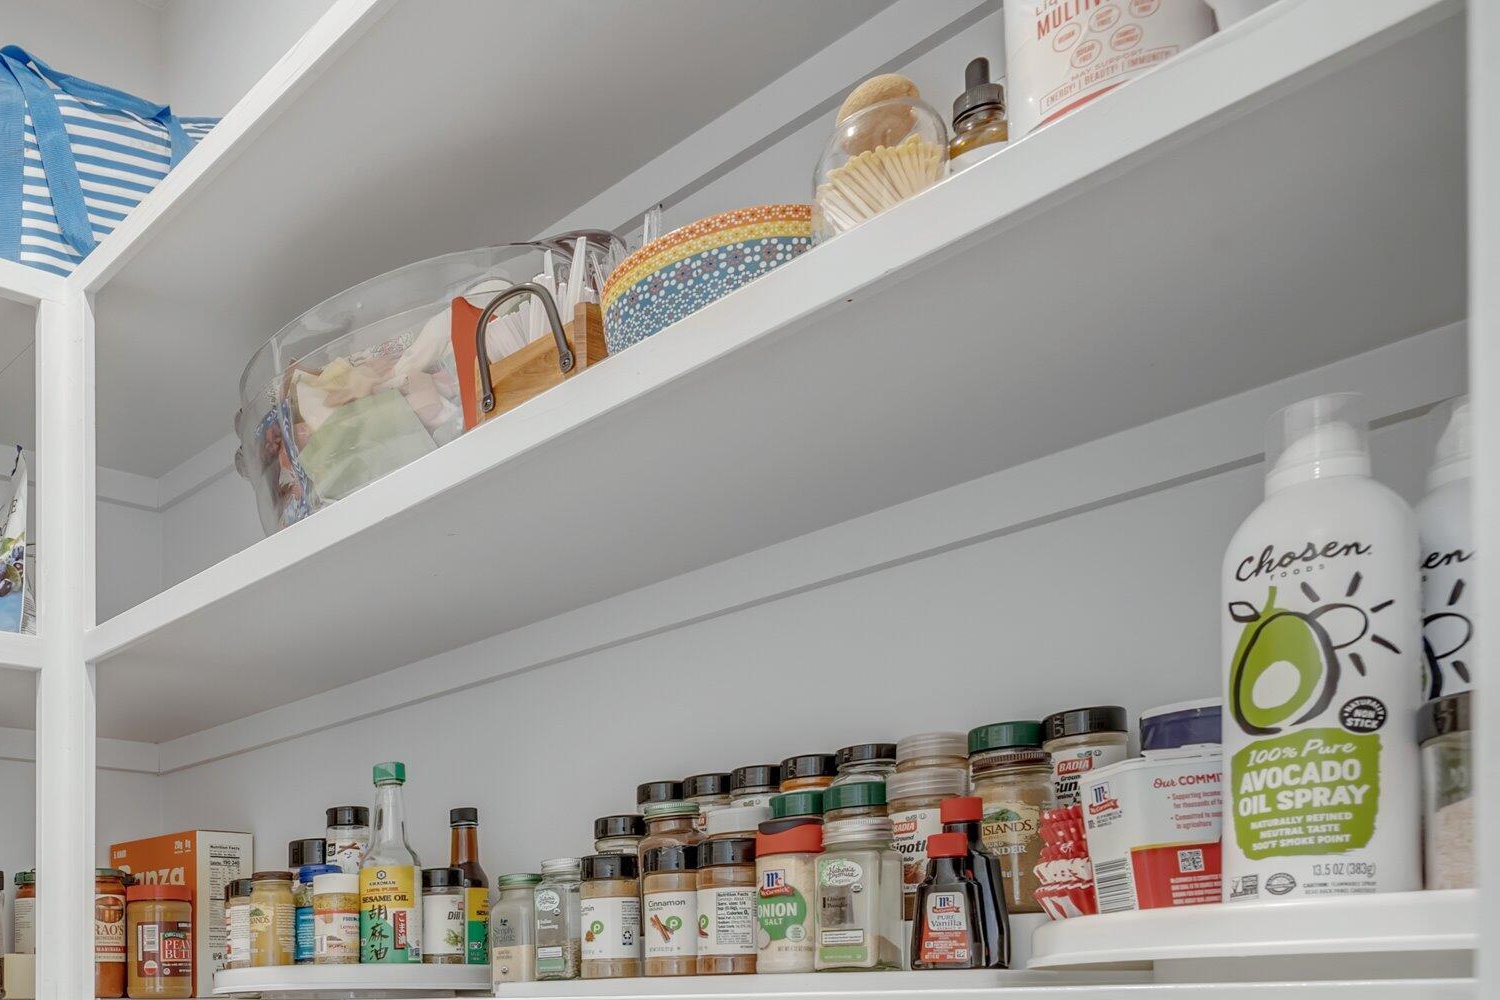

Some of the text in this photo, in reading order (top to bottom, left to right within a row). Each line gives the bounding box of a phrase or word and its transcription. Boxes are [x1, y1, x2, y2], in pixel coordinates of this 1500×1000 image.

[1235, 541, 1372, 582] Chosen
[1270, 563, 1325, 581] FOODS
[1344, 698, 1385, 715] NATURALLY
[1353, 708, 1375, 718] NON
[1346, 717, 1379, 729] STICK
[1247, 738, 1358, 767] 100% Pure
[1059, 759, 1089, 771] BADIA
[1153, 777, 1178, 788] Our
[1240, 758, 1362, 795] AVOCADO
[1238, 784, 1371, 817] OIL SPRAY
[1250, 812, 1353, 830] NATURALLY REFINED
[1259, 824, 1341, 839] NEUTRAL TASTE
[1280, 834, 1351, 847] SMOKE POINT
[828, 864, 856, 876] Nature's
[1312, 862, 1377, 878] 13.5 OZ (383g)
[362, 894, 409, 904] SESAME OIL
[648, 900, 686, 908] Cinnamon
[448, 911, 461, 920] Dill
[757, 902, 797, 918] ONION
[764, 918, 784, 926] SALT
[931, 919, 962, 927] Vanilla
[368, 904, 389, 961] 胡麻油
